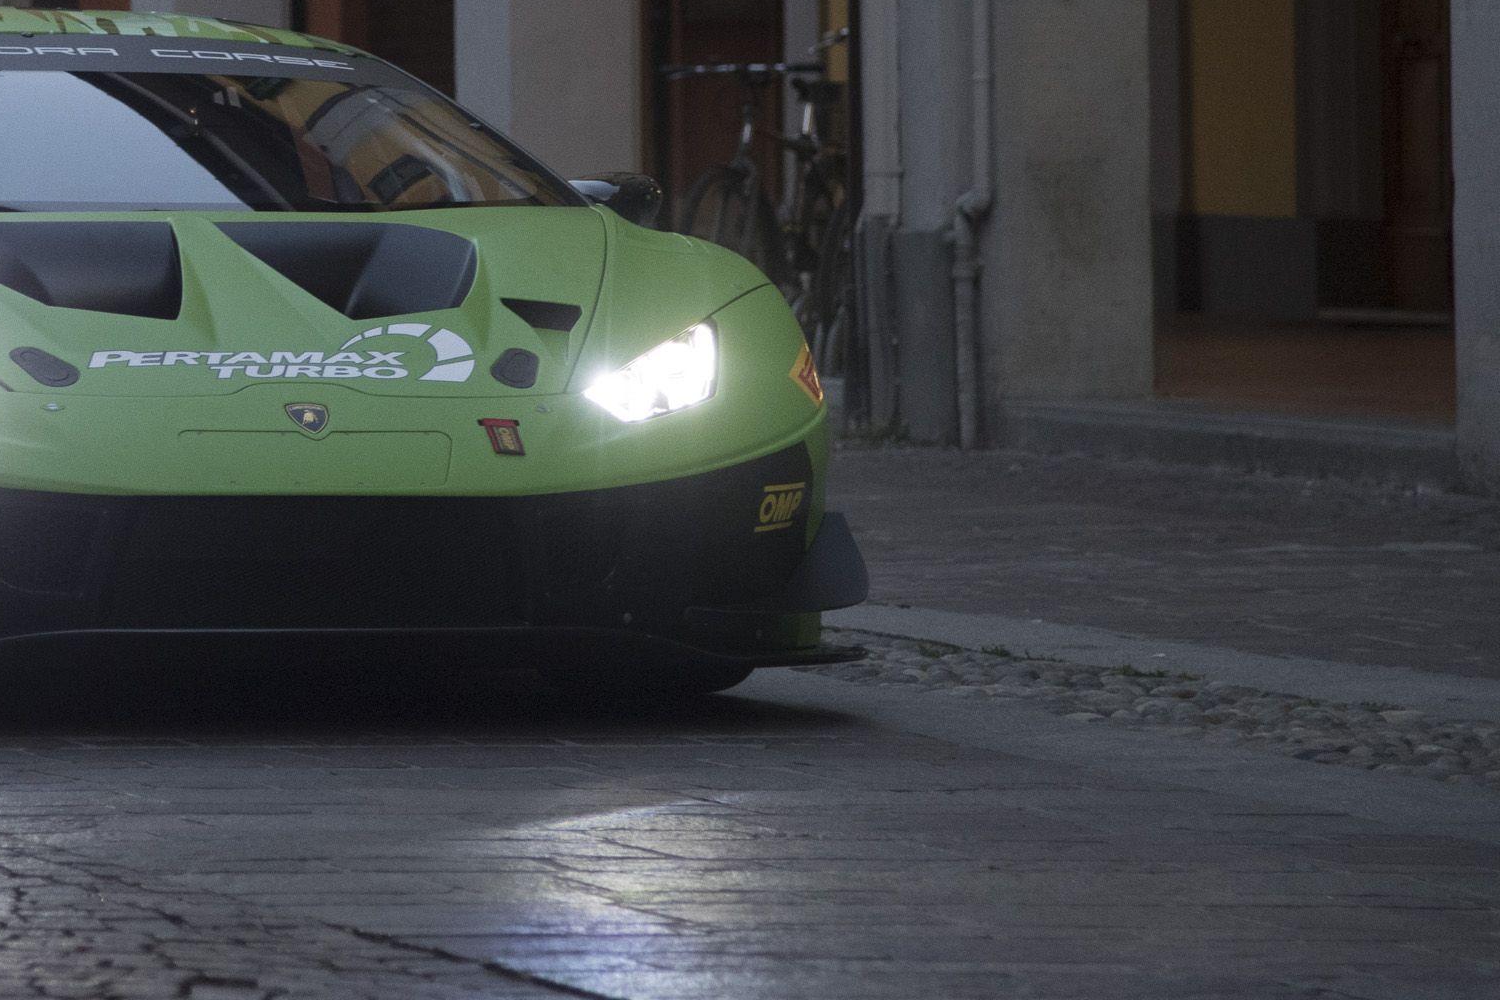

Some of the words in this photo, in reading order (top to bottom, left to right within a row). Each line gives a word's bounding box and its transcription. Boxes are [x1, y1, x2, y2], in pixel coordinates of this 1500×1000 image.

[150, 49, 356, 70] CORSE
[88, 350, 406, 368] PERTAMAX
[209, 365, 408, 379] TURBO
[759, 489, 803, 524] OMP
